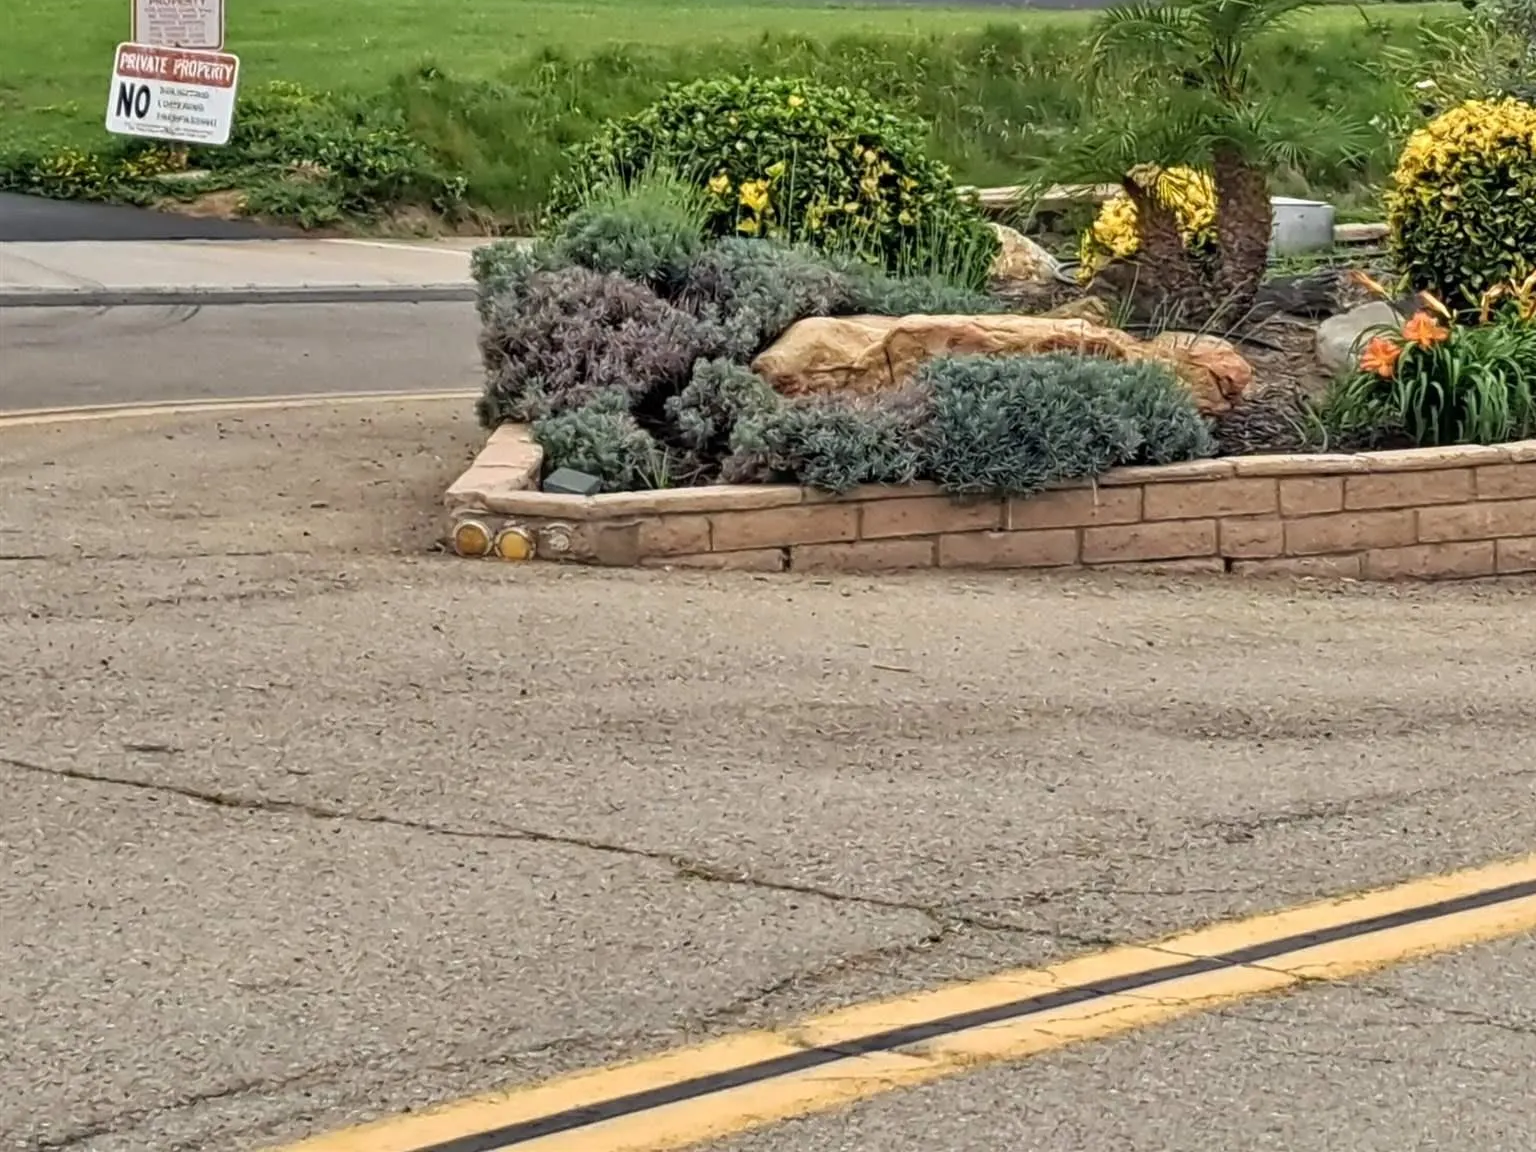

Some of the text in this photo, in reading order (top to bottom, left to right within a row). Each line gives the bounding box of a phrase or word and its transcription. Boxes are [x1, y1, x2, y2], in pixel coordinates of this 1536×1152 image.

[120, 52, 234, 83] PRIVATE PROPERTY
[115, 81, 151, 119] NO
